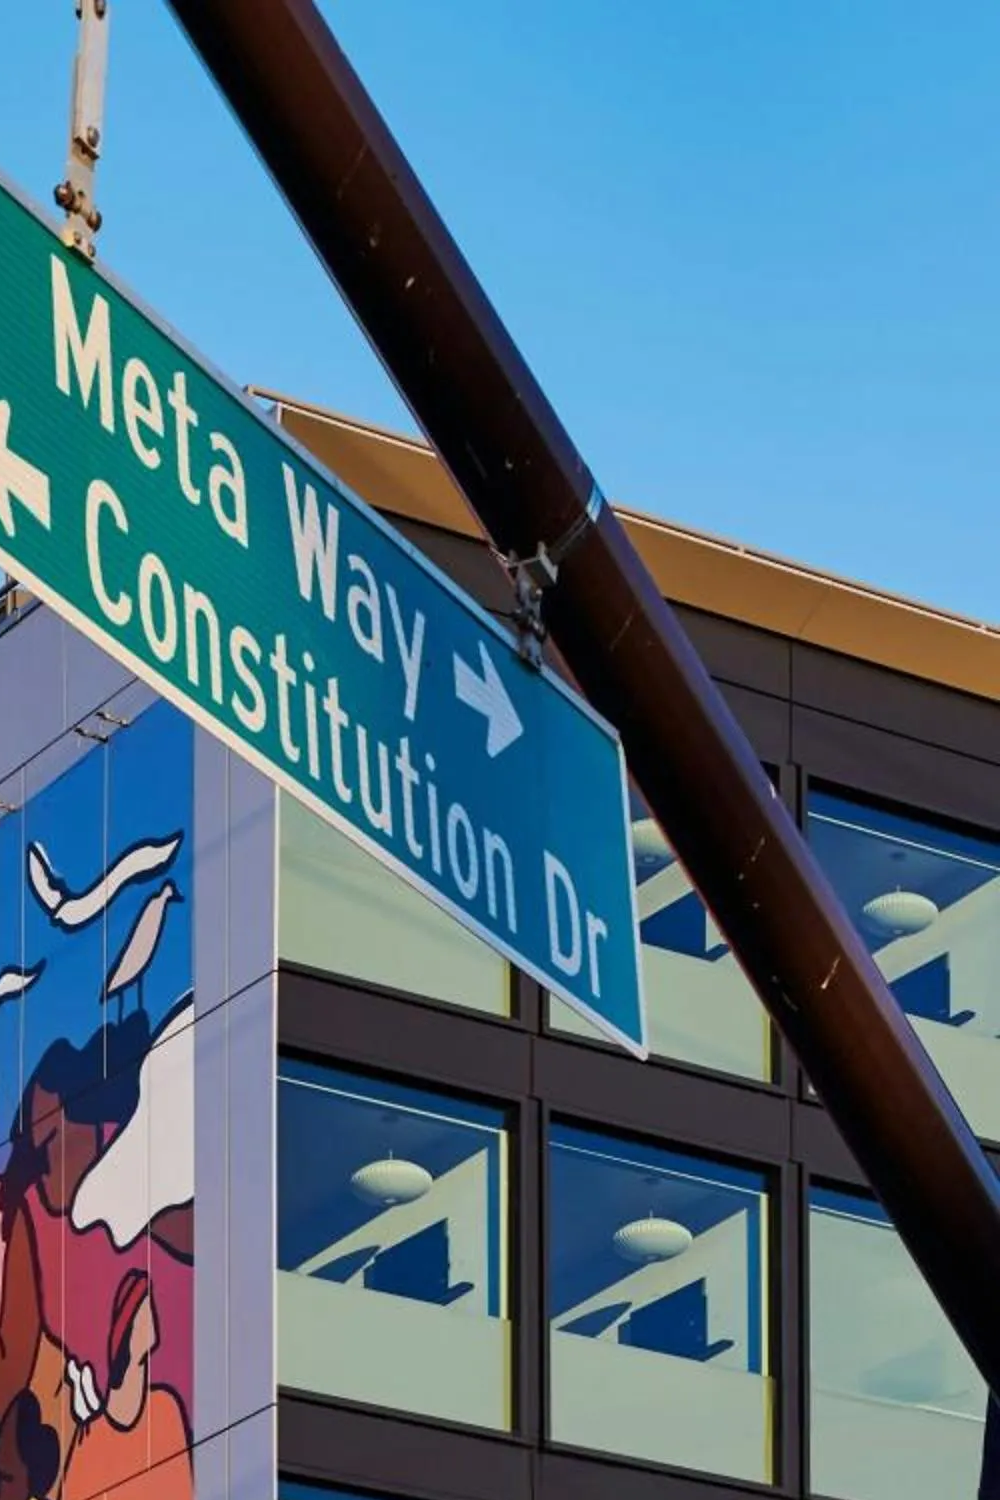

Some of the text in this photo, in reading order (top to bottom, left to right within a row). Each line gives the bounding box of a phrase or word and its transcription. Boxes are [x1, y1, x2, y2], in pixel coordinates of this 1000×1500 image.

[51, 253, 425, 720] Meta Way
[85, 478, 608, 998] Constitution Dr
